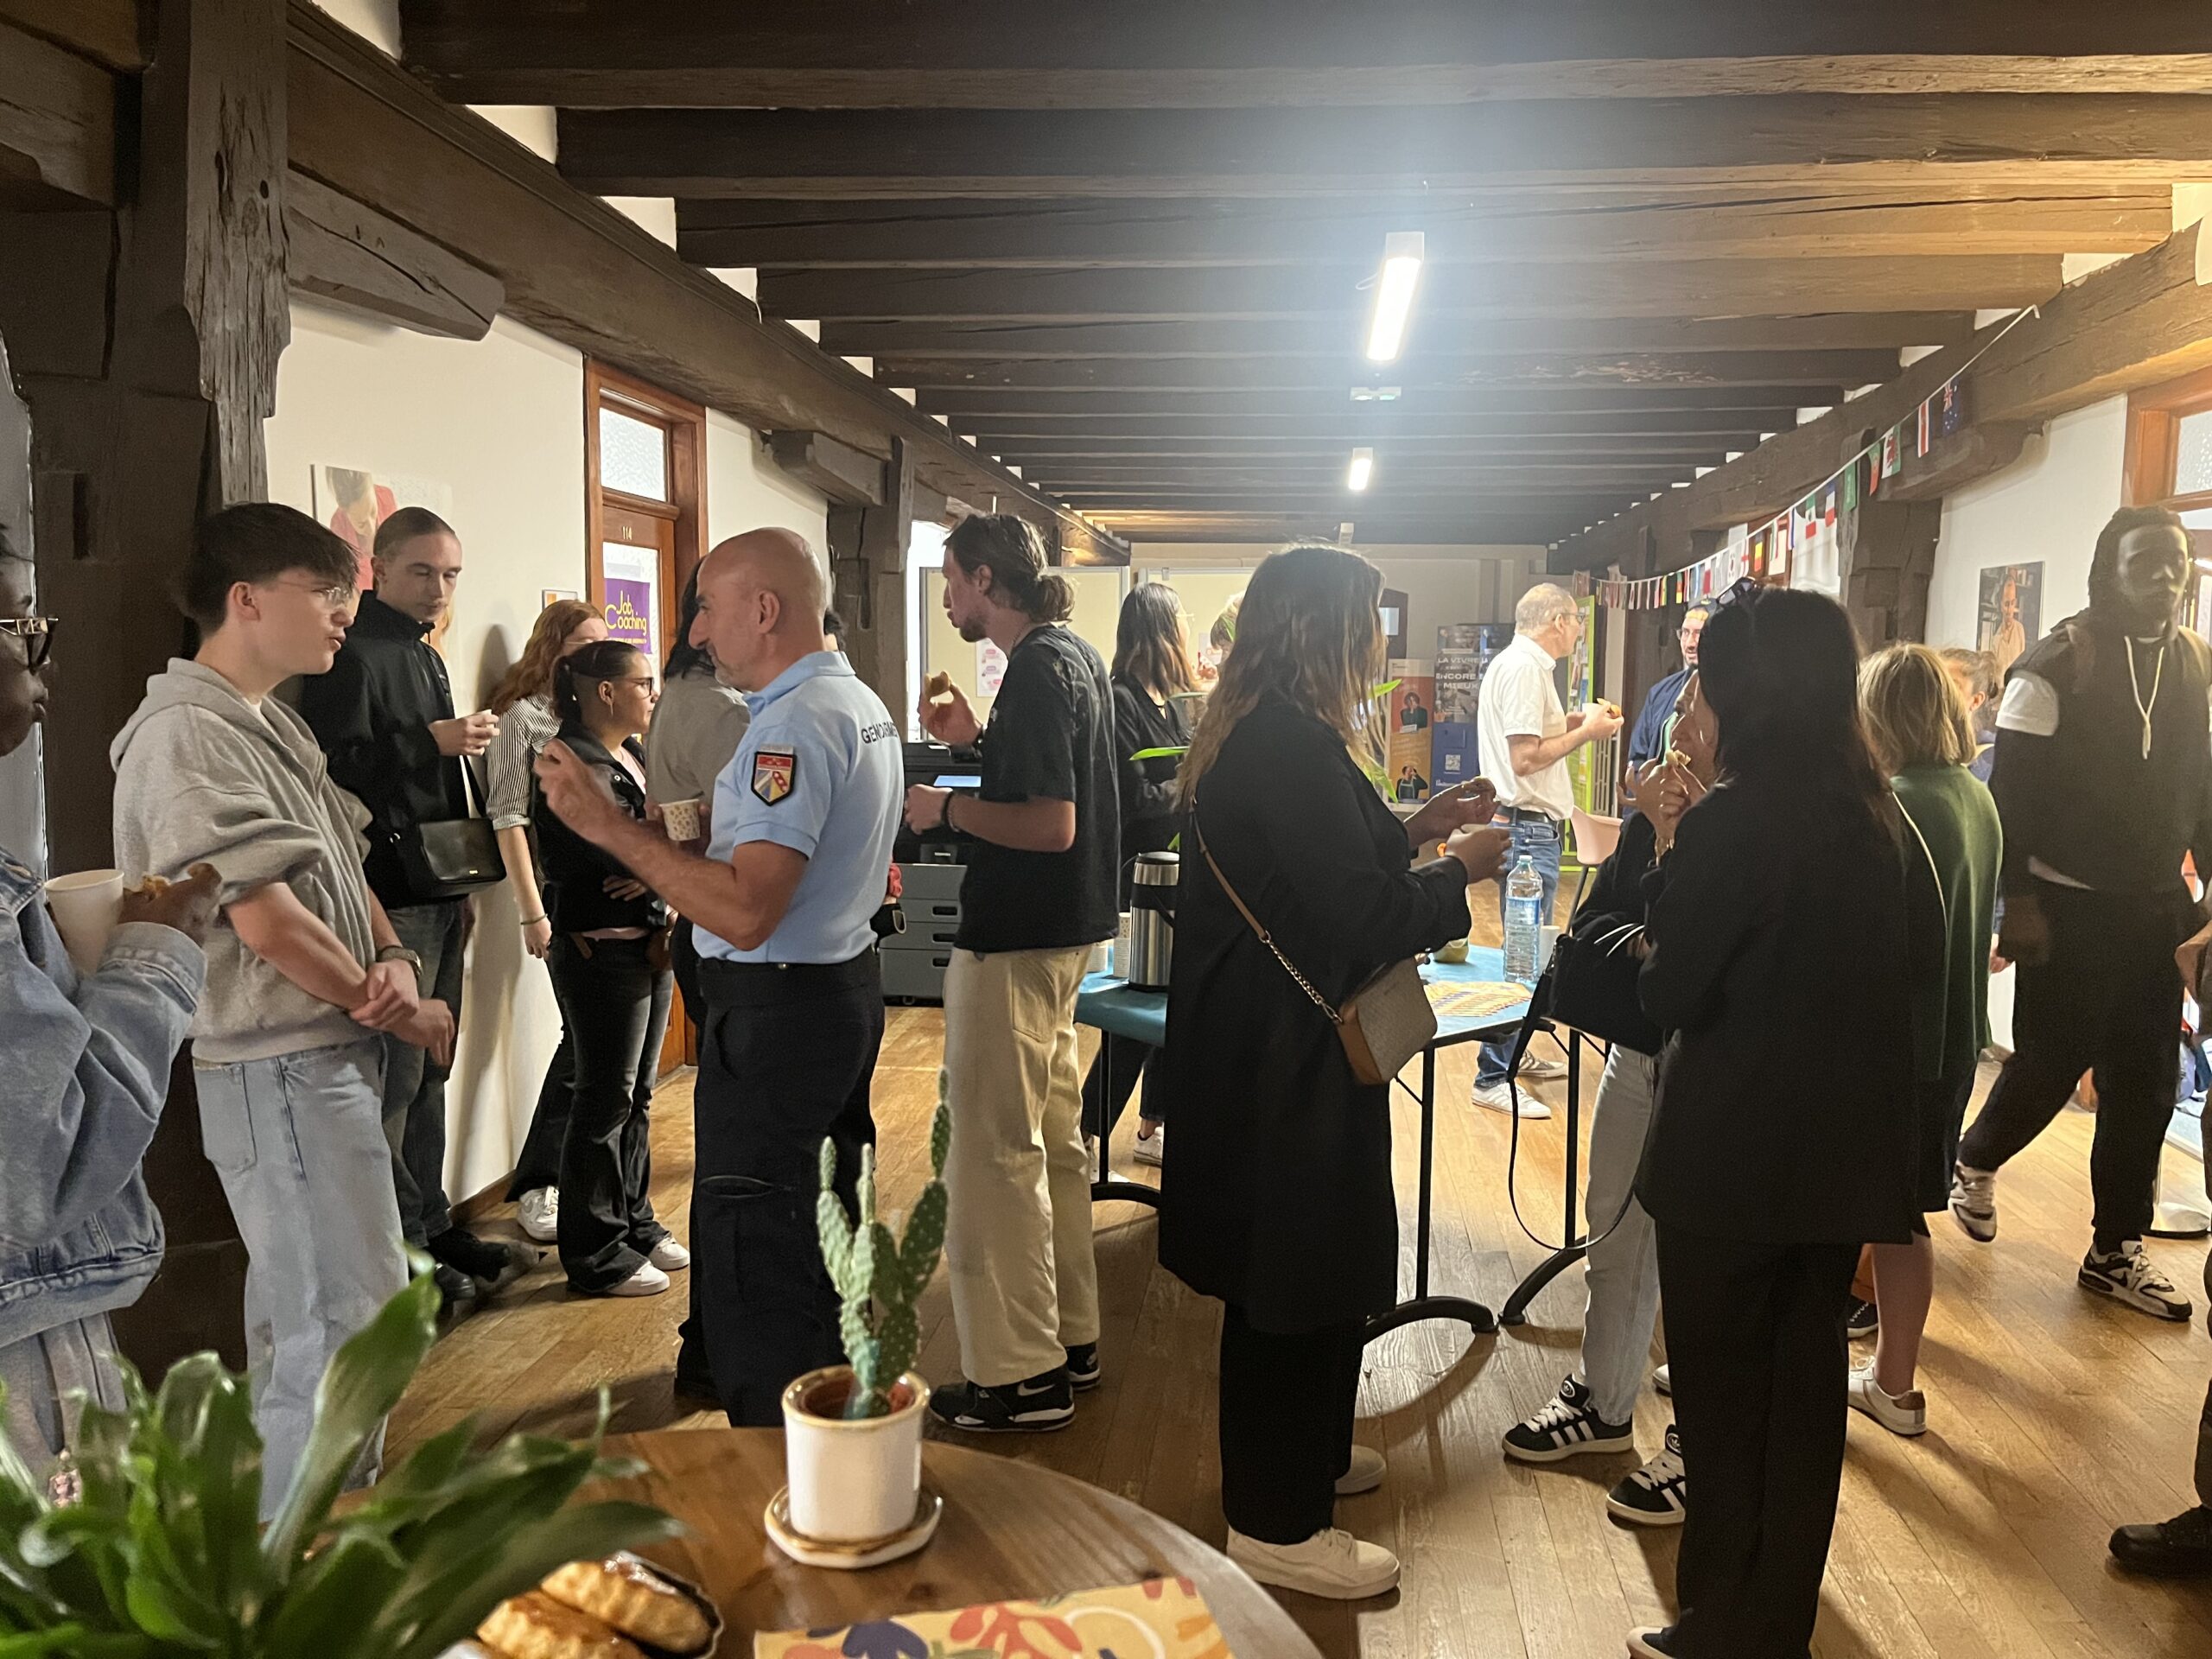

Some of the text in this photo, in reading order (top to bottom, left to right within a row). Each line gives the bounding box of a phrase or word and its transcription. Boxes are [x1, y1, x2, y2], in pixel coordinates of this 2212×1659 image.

[622, 525, 632, 540] 114
[616, 590, 632, 615] Job
[604, 604, 647, 637] Coaching
[1443, 682, 1478, 690] MIEUX
